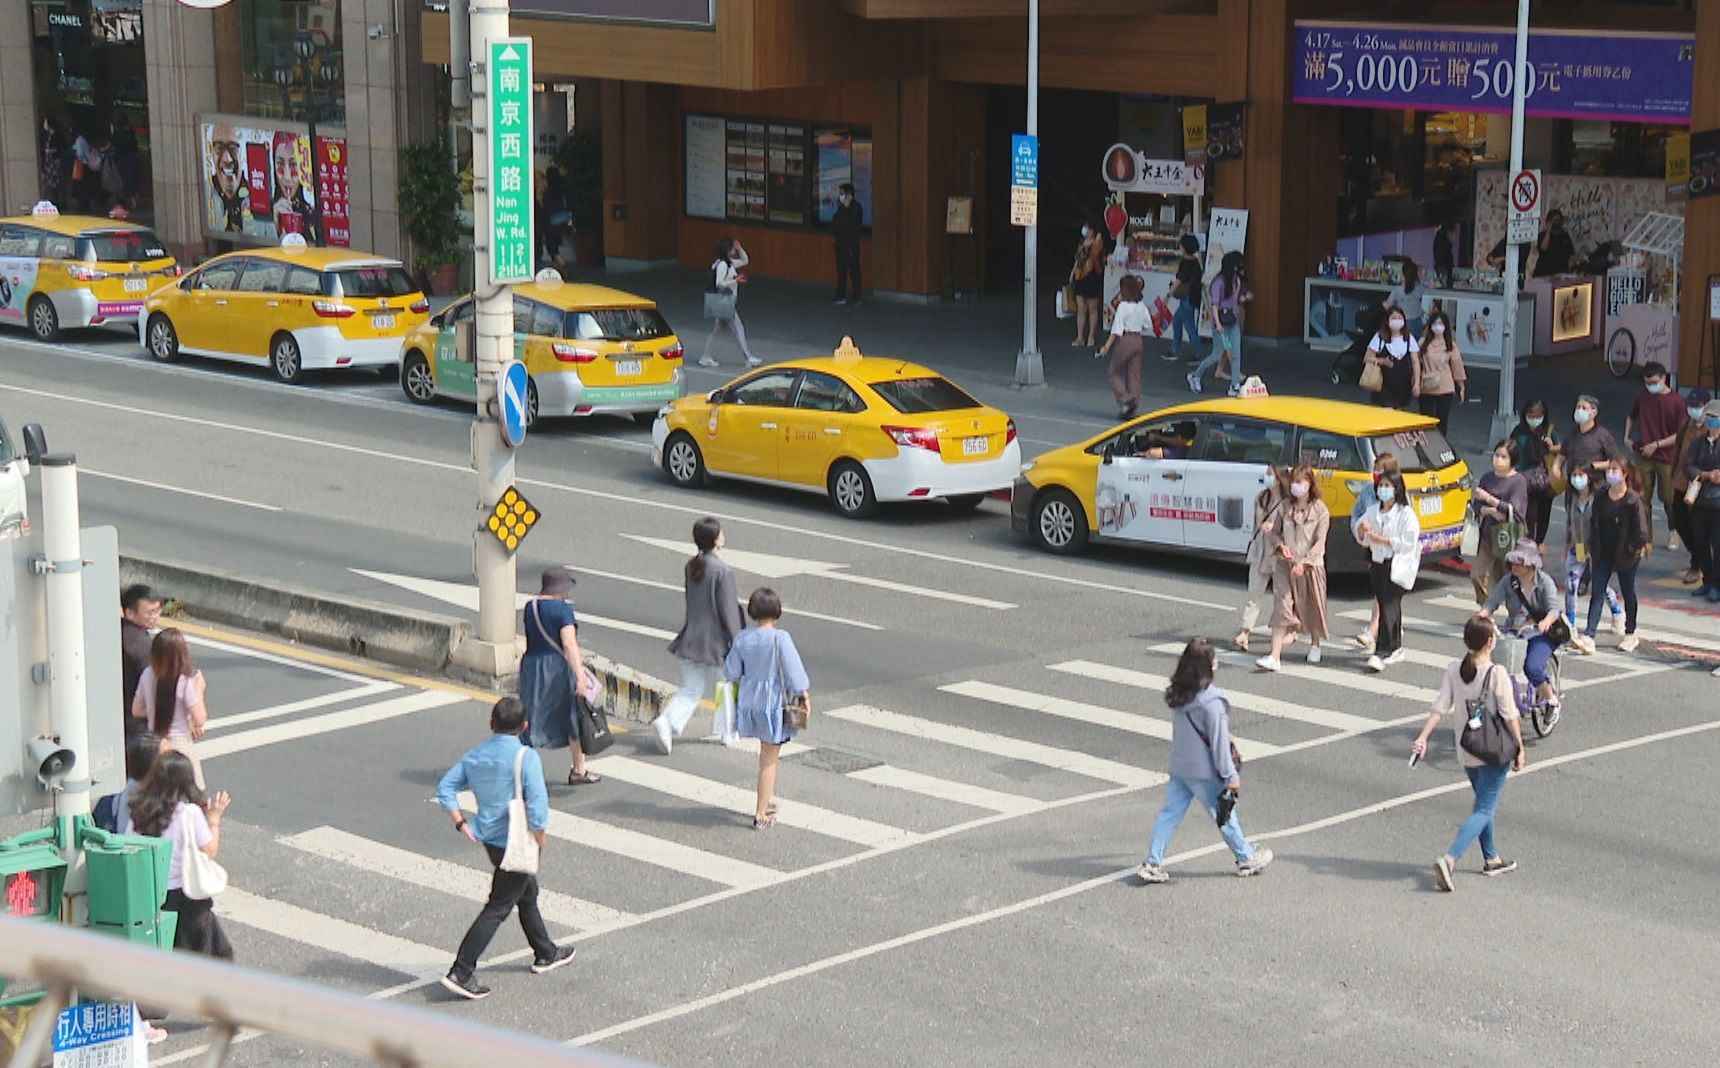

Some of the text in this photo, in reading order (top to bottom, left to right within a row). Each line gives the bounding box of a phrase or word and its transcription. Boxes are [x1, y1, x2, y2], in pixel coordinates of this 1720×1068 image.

[49, 13, 82, 27] CHANEL
[1304, 31, 1331, 49] 4.17
[1352, 33, 1379, 50] 4.26
[1304, 51, 1442, 96] 滿5,000元
[499, 66, 521, 192] 南京西路
[496, 196, 517, 208] Nan
[496, 211, 519, 226] Jing
[496, 226, 527, 240] W. Rd.
